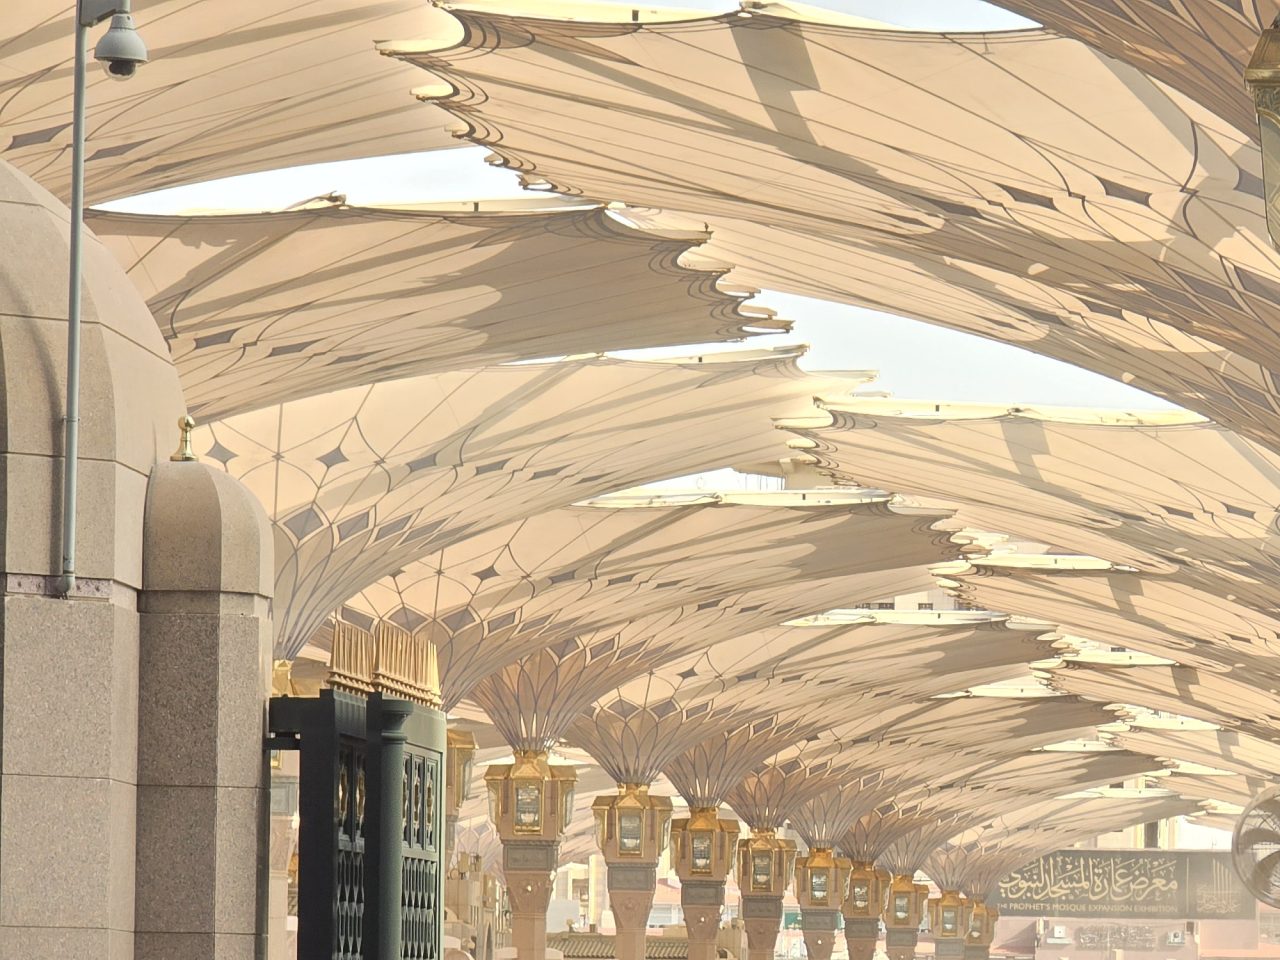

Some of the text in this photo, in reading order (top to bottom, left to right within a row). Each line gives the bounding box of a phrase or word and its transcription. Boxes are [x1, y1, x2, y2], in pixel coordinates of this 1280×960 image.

[1009, 903, 1051, 911] PROPHET'S
[1052, 904, 1087, 912] MOSQUE
[1088, 904, 1133, 912] EXPANSION
